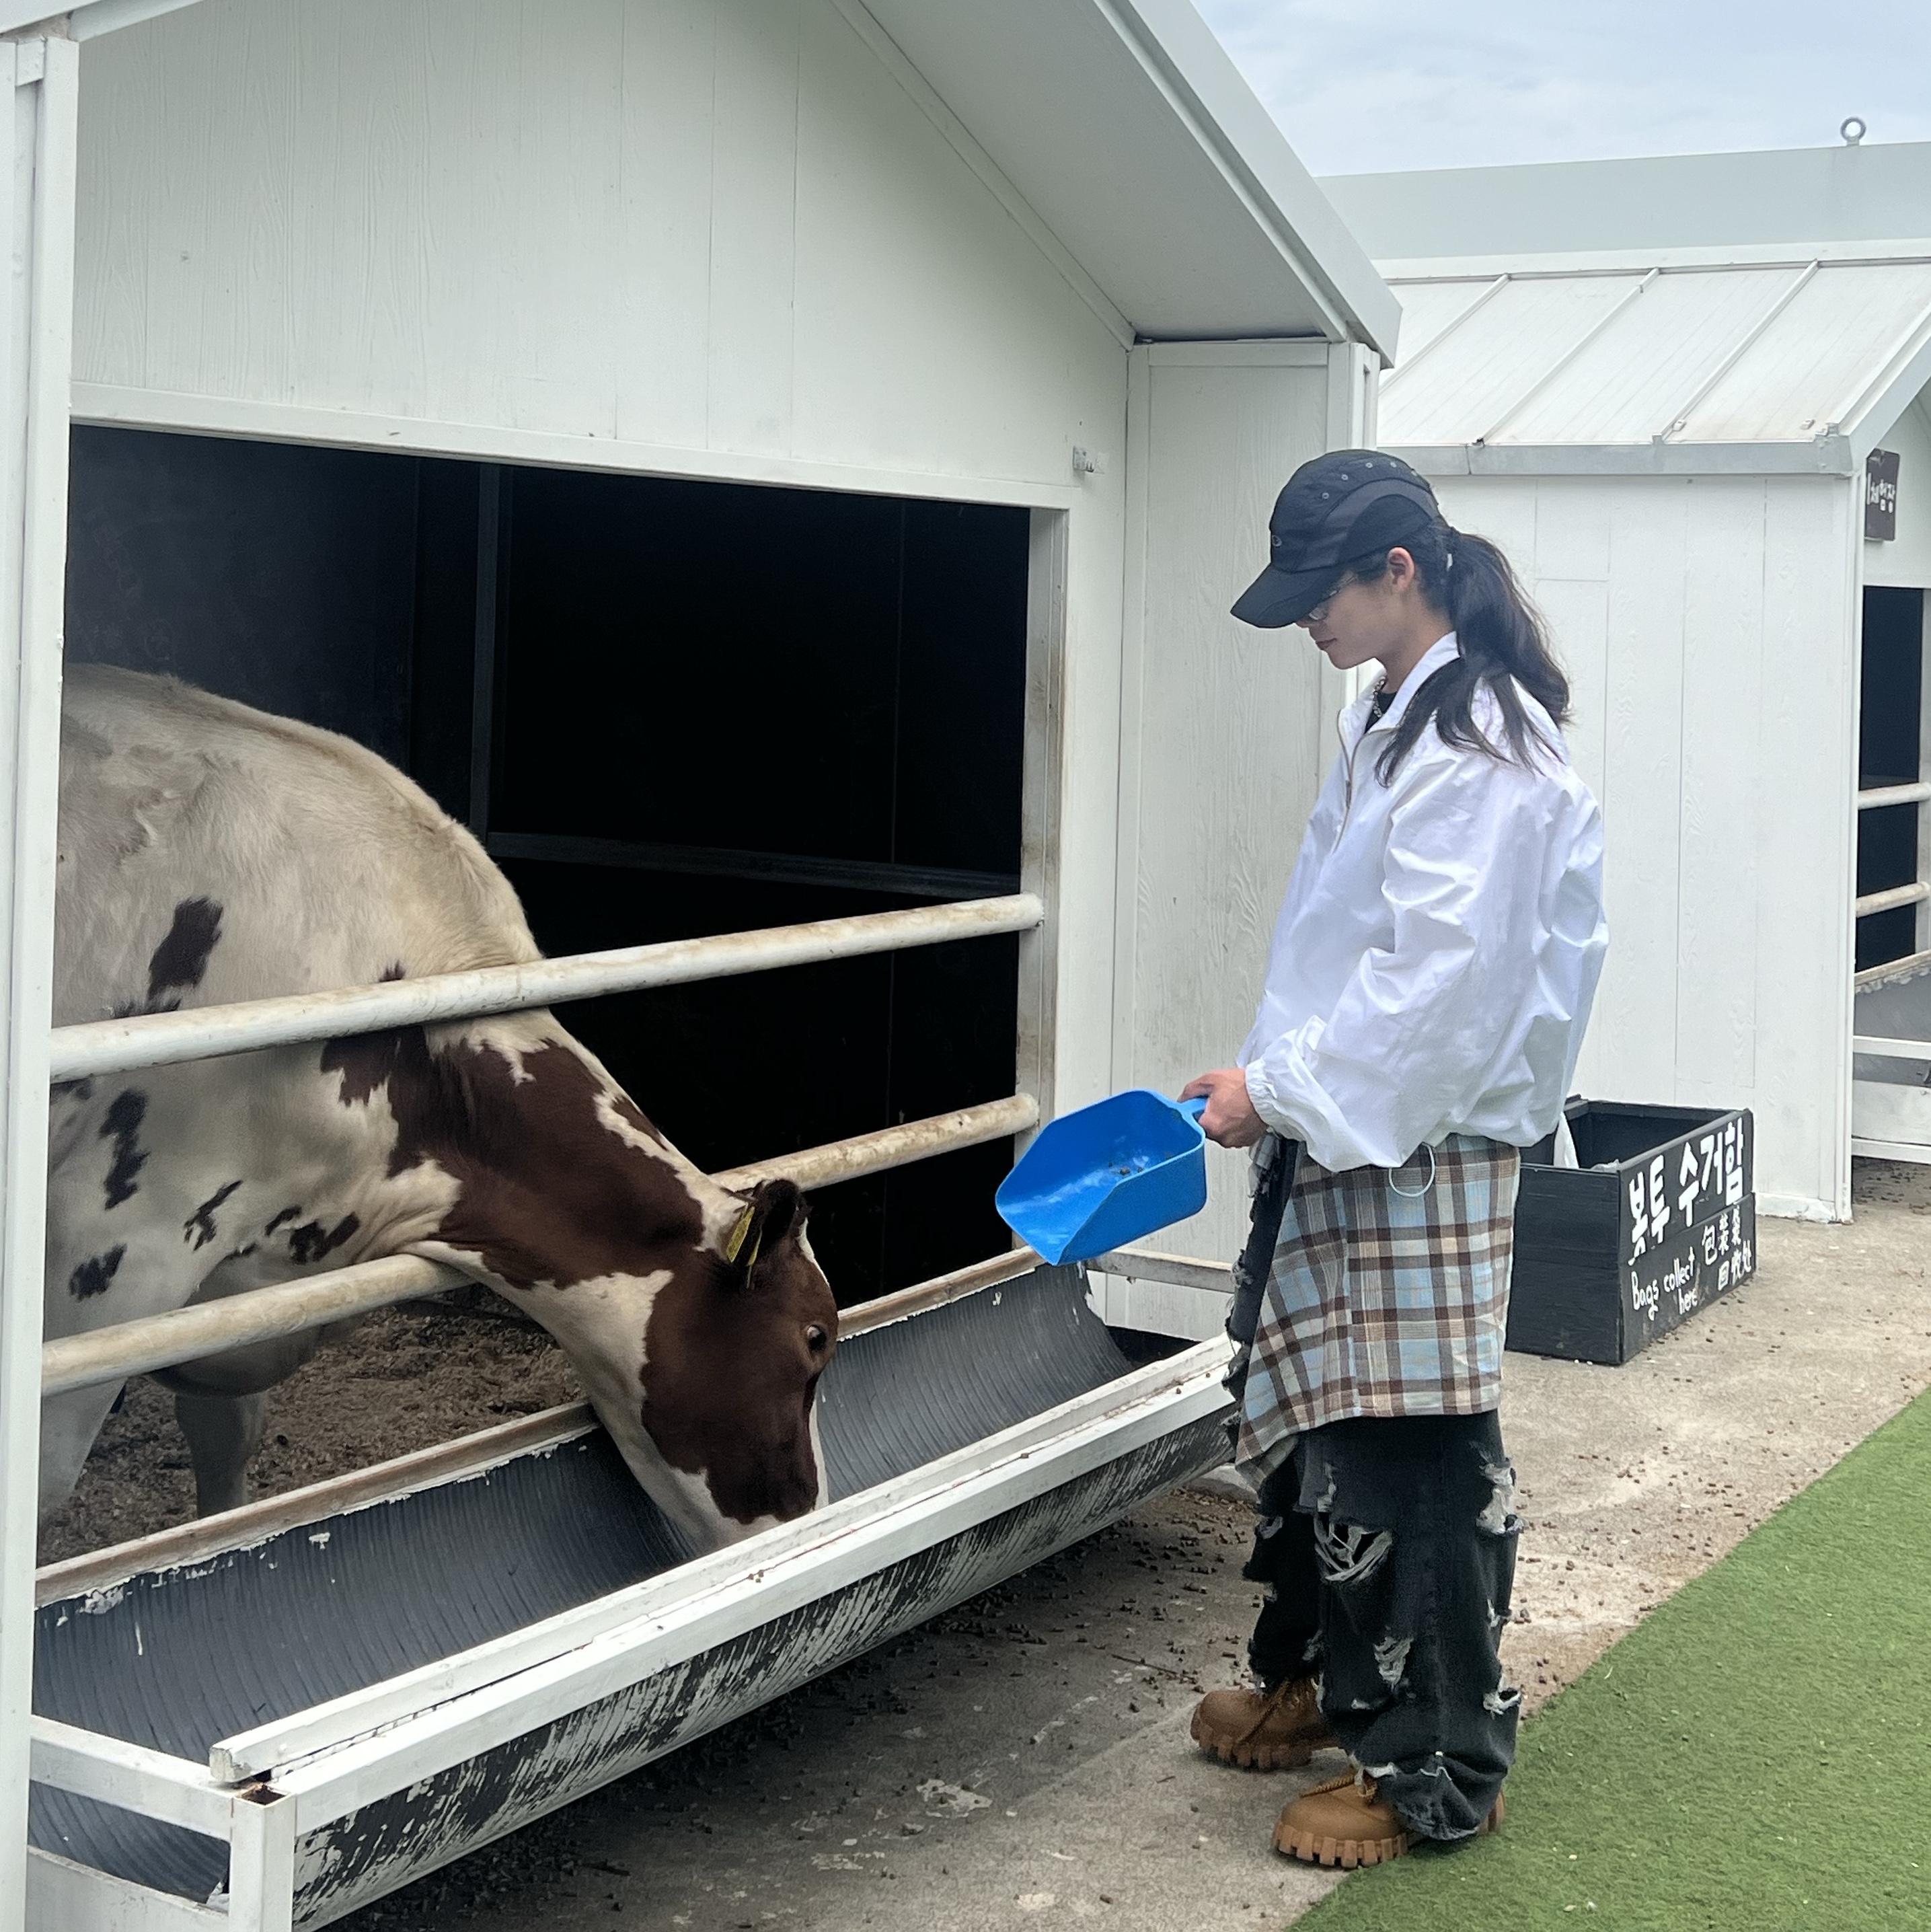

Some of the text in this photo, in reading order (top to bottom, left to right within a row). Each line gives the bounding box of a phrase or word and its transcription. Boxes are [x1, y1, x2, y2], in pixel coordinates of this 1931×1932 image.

[1629, 1117, 1744, 1265] 봉투 수거함
[1630, 1246, 1695, 1321] Bags collect
[1679, 1288, 1698, 1314] here
